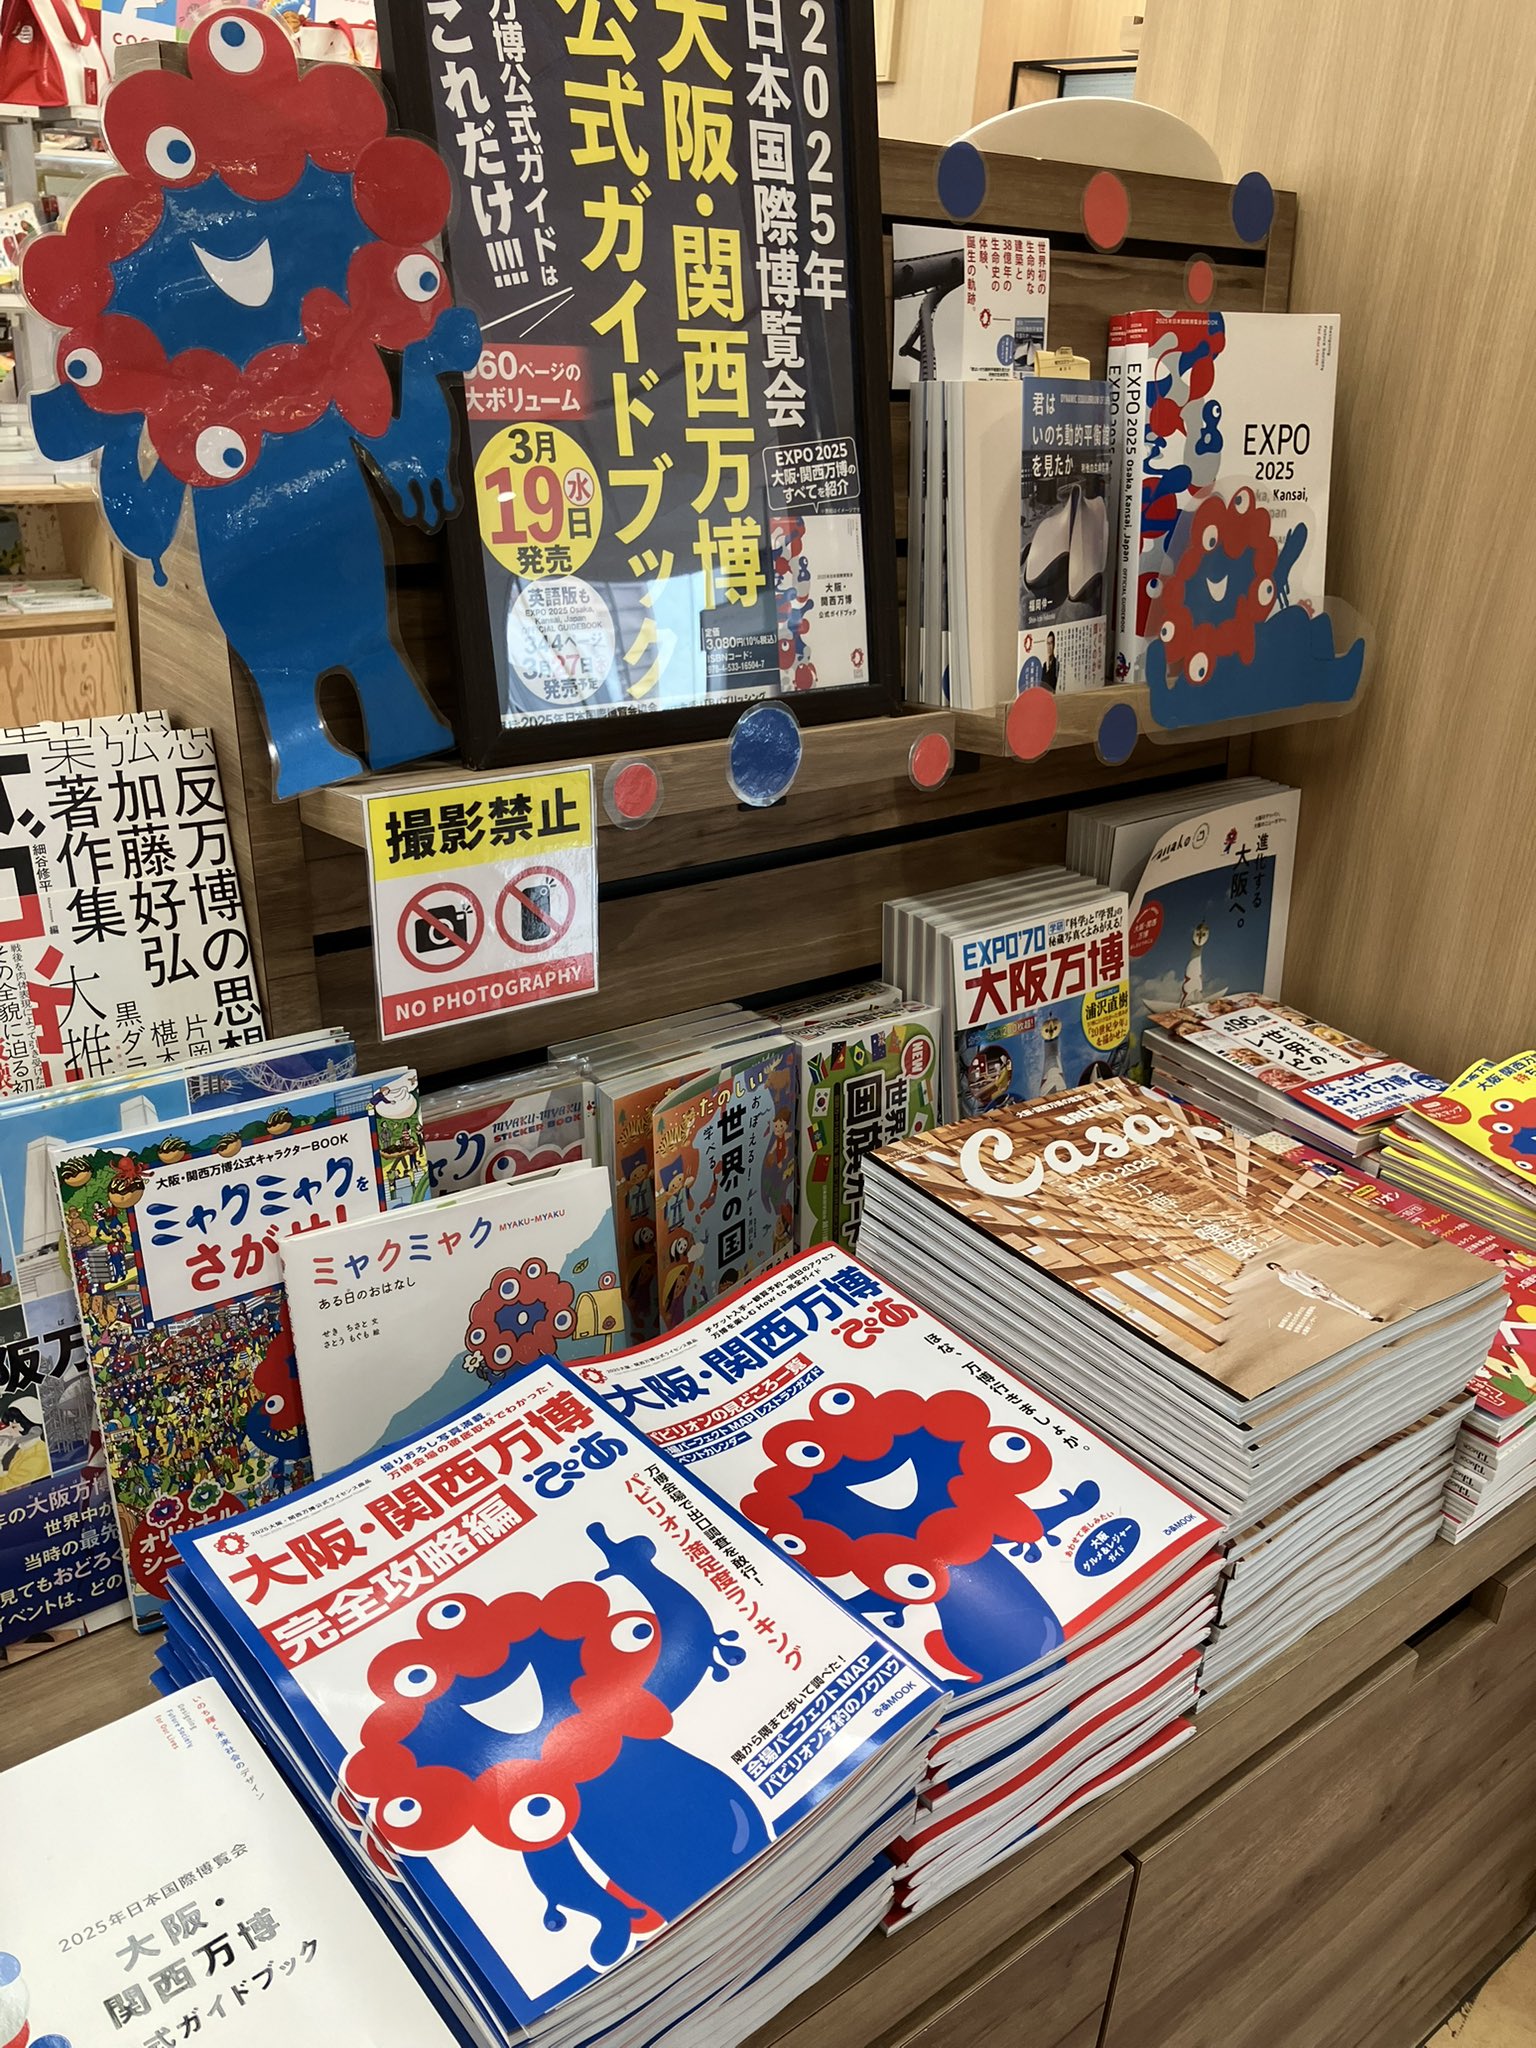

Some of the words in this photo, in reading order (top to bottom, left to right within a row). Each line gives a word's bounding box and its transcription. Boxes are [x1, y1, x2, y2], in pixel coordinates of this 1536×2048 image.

[800, 0, 847, 311] 2025年
[745, 0, 807, 429] 日本国際博覧会
[991, 238, 1001, 292] 生命史の
[1003, 238, 1013, 292] 38億年の
[1014, 239, 1024, 281] 建築と
[1026, 240, 1036, 295] 生命的な
[1038, 241, 1047, 295] 世界初の
[655, 0, 767, 610] 大阪・関西万博
[1032, 392, 1056, 416] 君は
[1126, 363, 1142, 416] EXPO
[508, 428, 558, 466] 3月
[775, 447, 814, 467] EXPO
[815, 442, 848, 461] 2025
[1032, 424, 1110, 447] いのち動的平衡館
[1125, 418, 1138, 455] 2025
[1243, 423, 1311, 455] EXPO
[771, 460, 857, 487] 大阪・関西万博の
[1032, 453, 1074, 478] を見たか
[1255, 461, 1295, 480] 2025
[485, 465, 564, 545] 19
[567, 477, 592, 501] 水
[782, 478, 849, 504] すべてを紹介
[1273, 488, 1308, 502] Kansai,
[516, 544, 573, 575] 発売
[1121, 533, 1132, 563] Japan
[525, 609, 547, 617] EXPO
[548, 607, 568, 615] 2025
[528, 586, 590, 608] 英語版も
[564, 614, 587, 623] Japan
[818, 607, 858, 619] 公式ガイドブック
[820, 593, 854, 607] 関西万博
[558, 621, 603, 632] GUIDEBOOK
[705, 626, 721, 638] 定価
[543, 677, 599, 700] 発売予定
[385, 787, 581, 864] 撮影禁止
[46, 773, 128, 946] 著作集
[108, 769, 200, 989] 加藤好弘
[1252, 833, 1269, 908] 進化する
[1229, 844, 1252, 929] 大阪へ。
[963, 925, 1046, 971] EXPO'70
[395, 999, 428, 1022] NO
[433, 965, 583, 1013] PHOTOGRAPHY
[965, 930, 1125, 1025] 大阪万博
[1085, 990, 1128, 1020] 浦沢直樹
[912, 1040, 924, 1072] NEW
[1243, 1037, 1313, 1072] レシピ
[1261, 1028, 1328, 1066] 世界の
[699, 1072, 764, 1118] たのしい
[1326, 1074, 1412, 1107] おうちで万博
[1477, 1053, 1536, 1091] 大阪・関西万
[492, 1101, 582, 1134] MYAKU-MYAKU
[494, 1124, 545, 1143] STICKER
[547, 1113, 582, 1129] BOOK
[1054, 1099, 1126, 1125] BRUTUS
[156, 1133, 349, 1191] 大阪・関西万博公式キャラクターBOOK
[703, 1125, 717, 1171] 学べる
[960, 1112, 1185, 1198] Casa
[717, 1103, 747, 1270] 世界の国
[1067, 1173, 1118, 1195] EXPO
[1114, 1156, 1159, 1180] 2025
[312, 1216, 493, 1286] ミャクミャク
[499, 1209, 566, 1232] MYAKU-MYAKU
[318, 1276, 417, 1311] ある日のおはなし
[711, 1307, 757, 1340] 万博を楽しむ
[756, 1295, 778, 1311] How
[777, 1288, 788, 1298] to
[786, 1268, 822, 1291] 完全ガイド
[322, 1327, 339, 1339] せき
[346, 1320, 368, 1334] ちさと
[324, 1336, 346, 1350] さとう
[349, 1330, 370, 1343] もぐも
[600, 1265, 885, 1420] 大阪・関西万博
[831, 1296, 918, 1350] ぴあ
[729, 1413, 755, 1433] MAP
[755, 1367, 822, 1417] レストランガイド
[924, 1332, 1092, 1452] ほな、万博行きましょか。
[387, 1381, 555, 1481] 万博会場の徹底取材でわかった!
[521, 1430, 629, 1499] ぴあ
[227, 1389, 598, 1607] 大阪・関西万博
[644, 1463, 765, 1587] 万博会場で出口調査を敢行!
[1065, 1510, 1115, 1558] あわせて楽しみたい
[1082, 1523, 1134, 1572] グルメ&レジャー
[1090, 1530, 1110, 1549] 大阪
[1162, 1513, 1197, 1536] ぴあMOOK
[270, 1491, 523, 1663] 完全攻略編
[623, 1471, 803, 1672] パビリオン満足度ランキング
[1108, 1545, 1127, 1564] ガイド
[730, 1654, 848, 1766] 隅から隅まで歩いて調べた!
[746, 1686, 840, 1780] 会場パーフェクト
[839, 1654, 872, 1689] MAP
[871, 1680, 918, 1719] ぴあMOOK
[764, 1658, 901, 1797] パビリオン予約のノウハウ
[58, 1841, 249, 1953] 2025年日本国際博覧会
[115, 1896, 226, 1973] 大阪・
[102, 1906, 281, 2031] 関西万博
